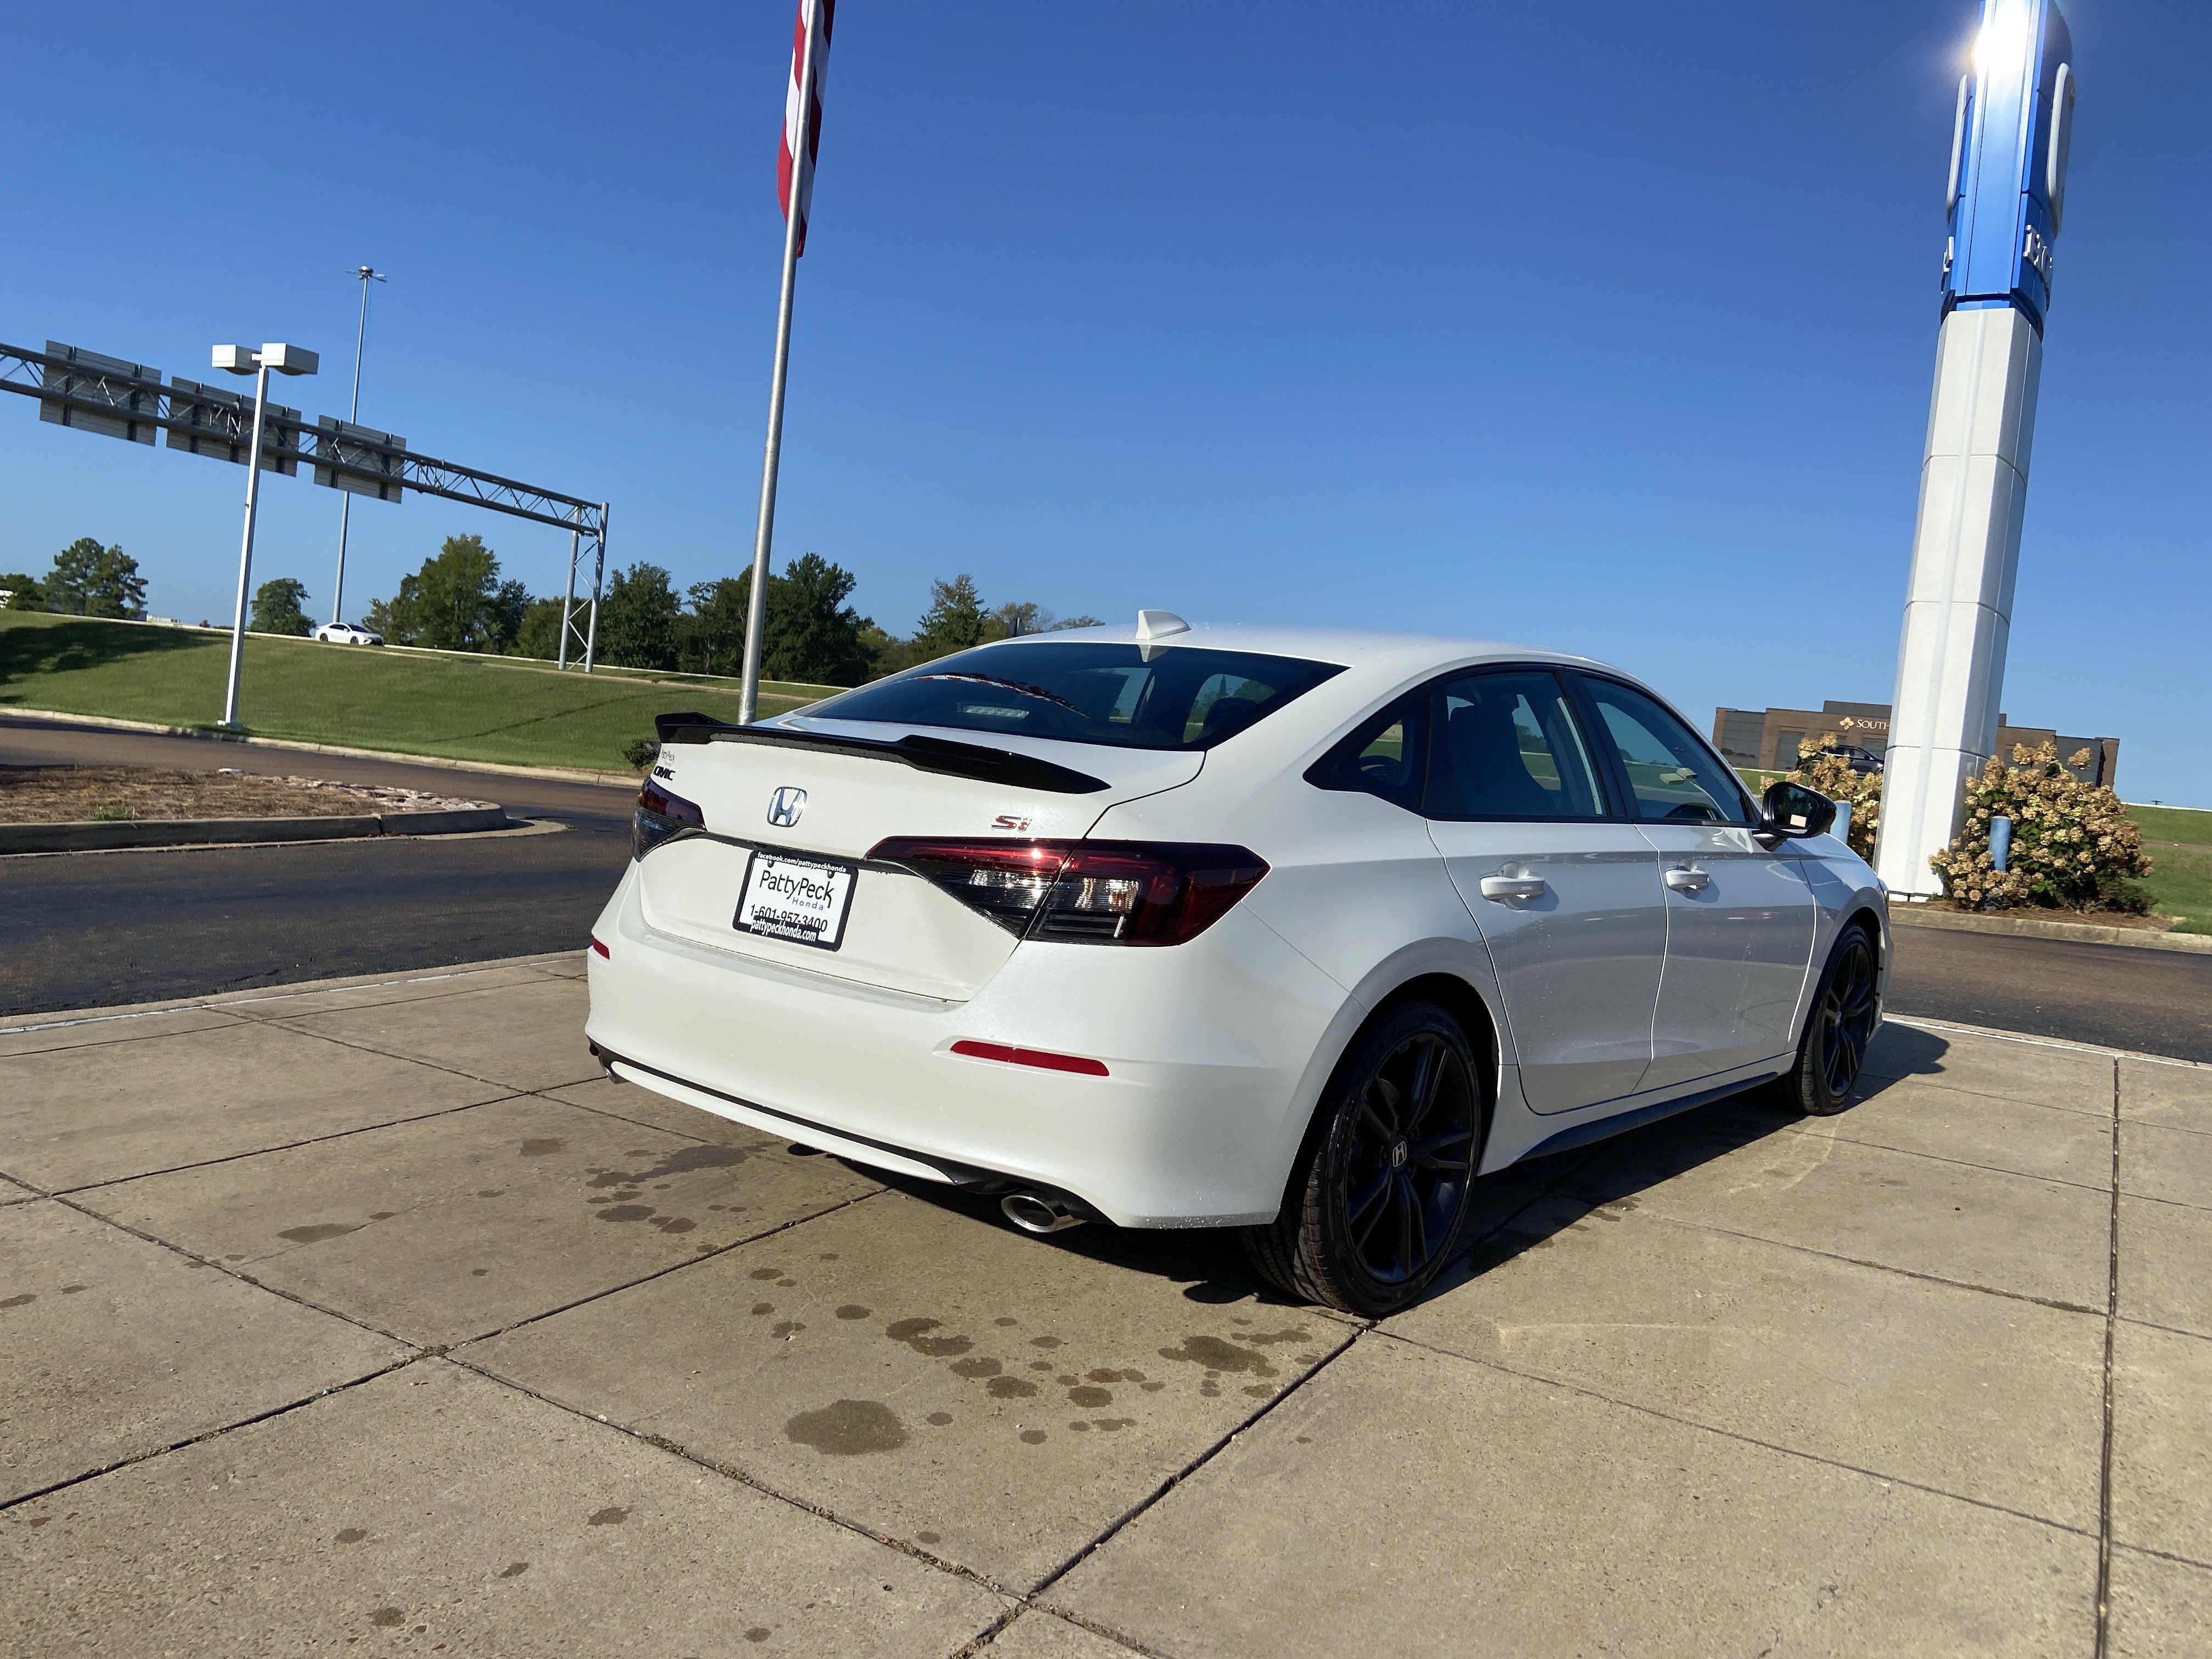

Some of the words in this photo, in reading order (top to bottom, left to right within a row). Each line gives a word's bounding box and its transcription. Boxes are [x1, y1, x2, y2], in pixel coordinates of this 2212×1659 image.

[990, 815, 1032, 832] Si
[757, 851, 847, 873] facebook.com/pattypeckhonda
[759, 870, 834, 909] PattyPeck
[792, 897, 824, 911] Honda
[749, 918, 817, 942] pattypeckhonda.com
[750, 904, 828, 933] 1-601-957-3400
